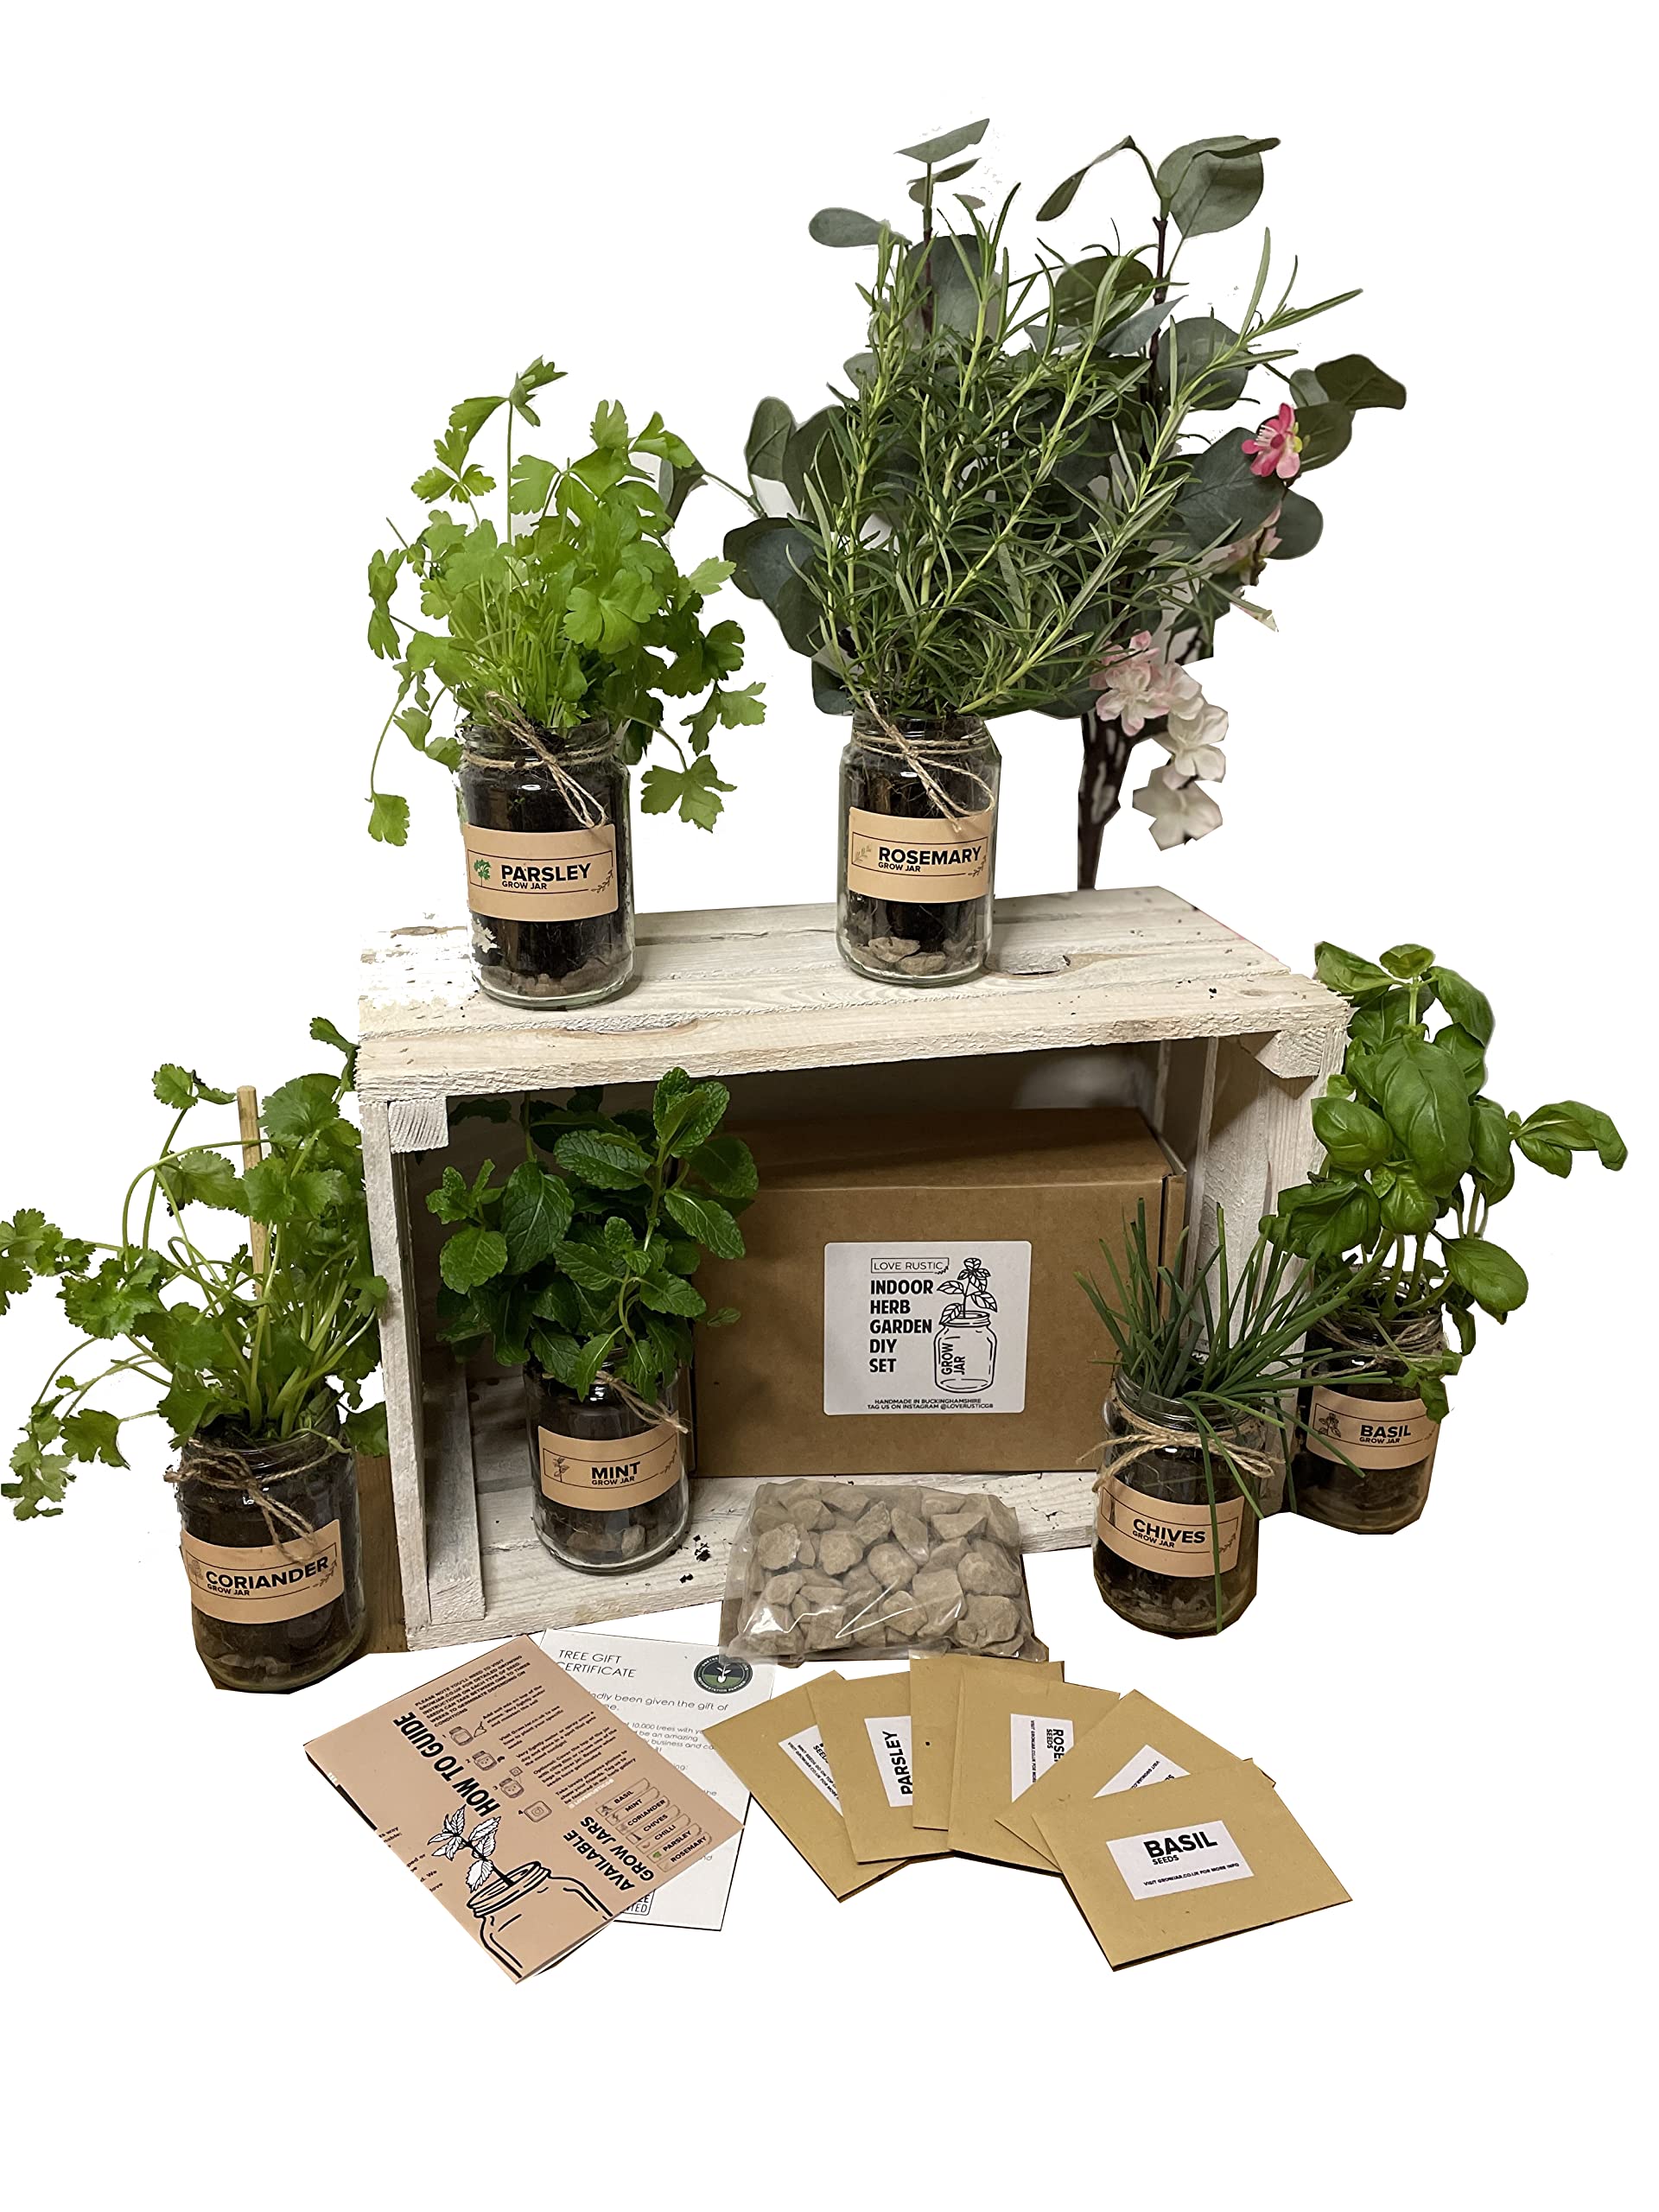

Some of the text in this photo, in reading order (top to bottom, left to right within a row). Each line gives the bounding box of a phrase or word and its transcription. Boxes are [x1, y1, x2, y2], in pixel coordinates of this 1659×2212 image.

[879, 845, 982, 866] ROSEMARY
[501, 862, 591, 882] PARSLEY
[878, 861, 904, 871] GROW
[501, 880, 528, 890] GROW
[874, 1261, 944, 1270] LOVE RUSTIC
[870, 1279, 933, 1294] INDOOR
[870, 1300, 911, 1314] HERB
[869, 1319, 932, 1334] GARDEN
[869, 1338, 898, 1353] DIY
[869, 1358, 897, 1373] SET
[941, 1342, 954, 1376] GROW
[953, 1356, 966, 1376] JAR
[1360, 1424, 1411, 1439] BASIL
[591, 1461, 641, 1479] MINT
[620, 1476, 635, 1484] JAR
[1133, 1518, 1206, 1544] CHIVES
[1133, 1530, 1158, 1544] GROW
[206, 1555, 329, 1590] CORIANDER
[207, 1583, 232, 1595] GROW
[559, 1649, 621, 1664] TREE GIFT
[414, 1694, 435, 1707] PLEASE
[614, 1694, 643, 1703] been
[645, 1697, 675, 1706] given
[677, 1700, 696, 1708] the
[697, 1702, 714, 1711] gift
[1052, 1728, 1065, 1762] ROSE
[393, 1712, 500, 1816] HOW TO GUIDE
[881, 1730, 913, 1796] PARSLEY
[613, 1790, 634, 1804] BASIL
[624, 1798, 642, 1812] MINT
[627, 1799, 665, 1826] CORIANDER
[643, 1814, 668, 1832] CHIVES
[654, 1824, 677, 1840] CHILLI
[580, 1816, 654, 1881] GROW JARS
[662, 1830, 691, 1852] PARSLEY
[670, 1835, 707, 1862] ROSEMARY
[1143, 1831, 1218, 1859] BASIL
[563, 1829, 634, 1891] AVAILABLE
[1152, 1854, 1179, 1866] SEEDS
